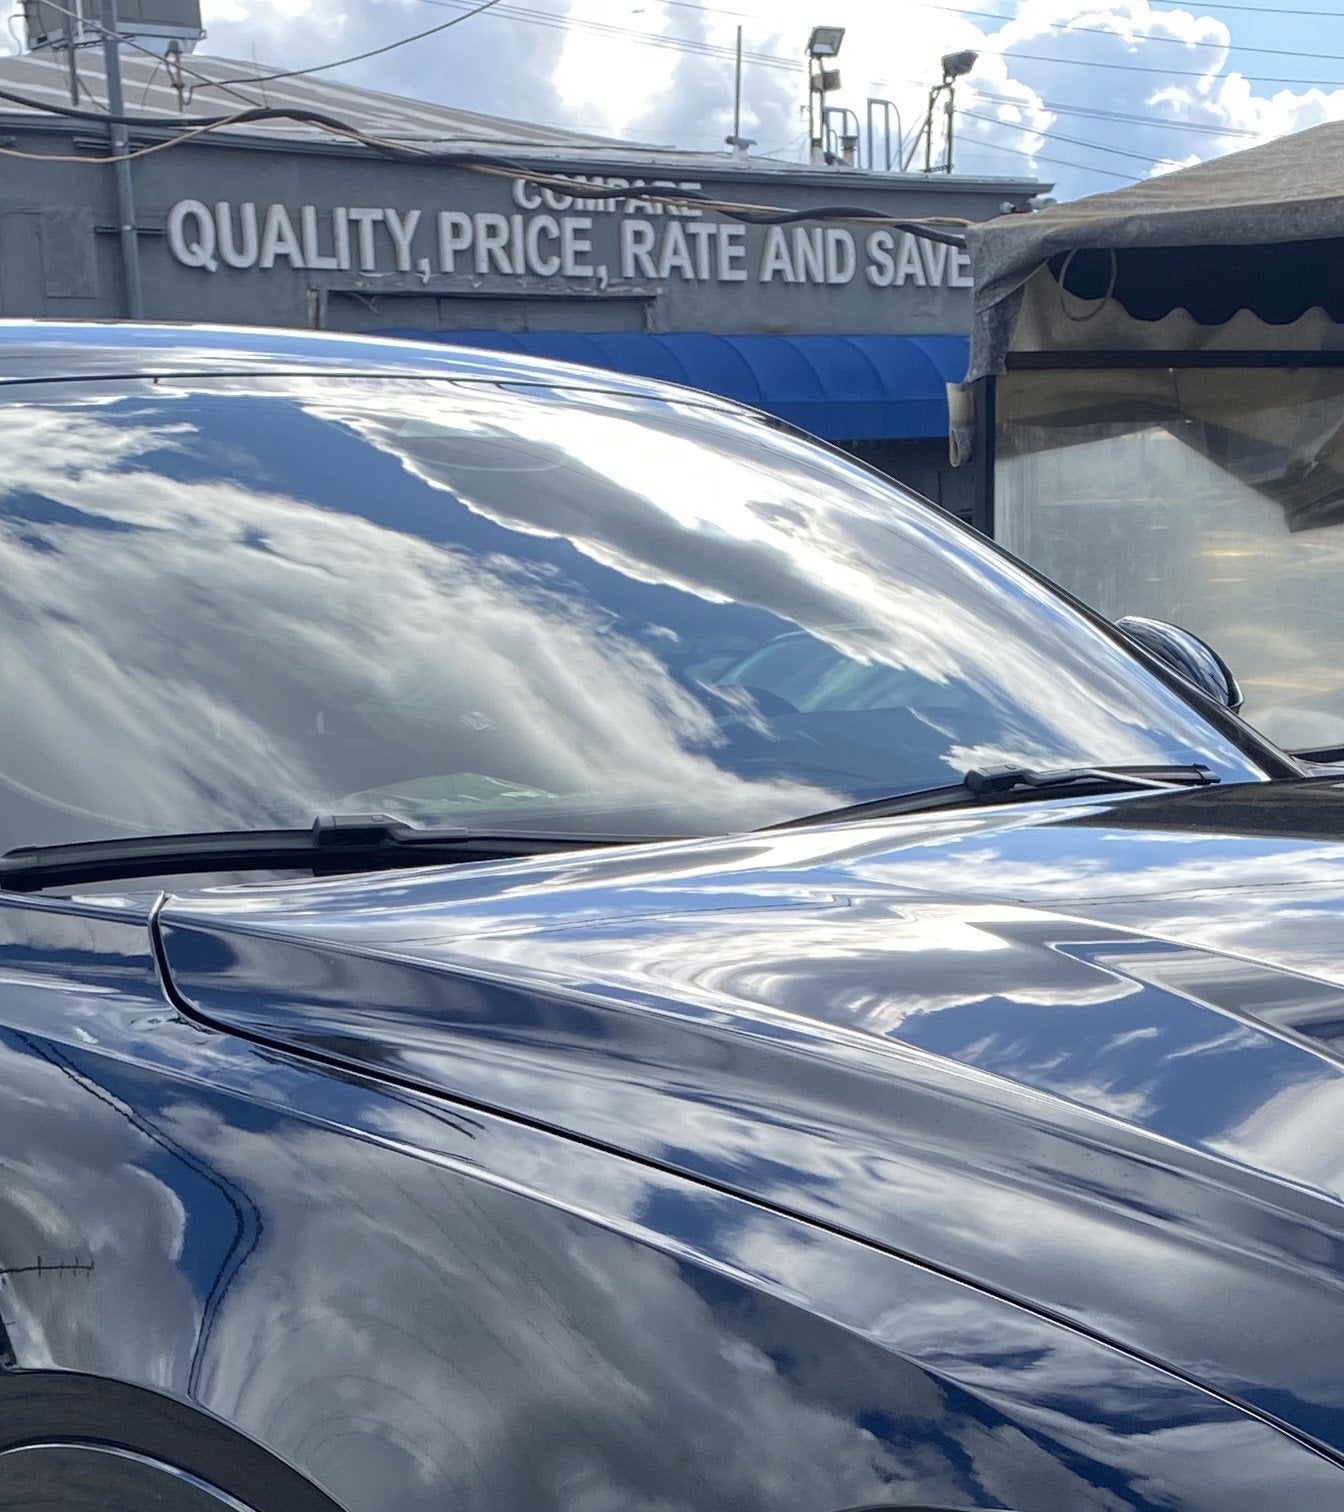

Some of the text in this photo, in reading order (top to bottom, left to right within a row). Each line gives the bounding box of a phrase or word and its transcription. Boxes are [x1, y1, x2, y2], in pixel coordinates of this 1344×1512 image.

[512, 174, 703, 218] COMPARE
[166, 198, 975, 290] QUALITY, PRICE, RATE AND SAVE
